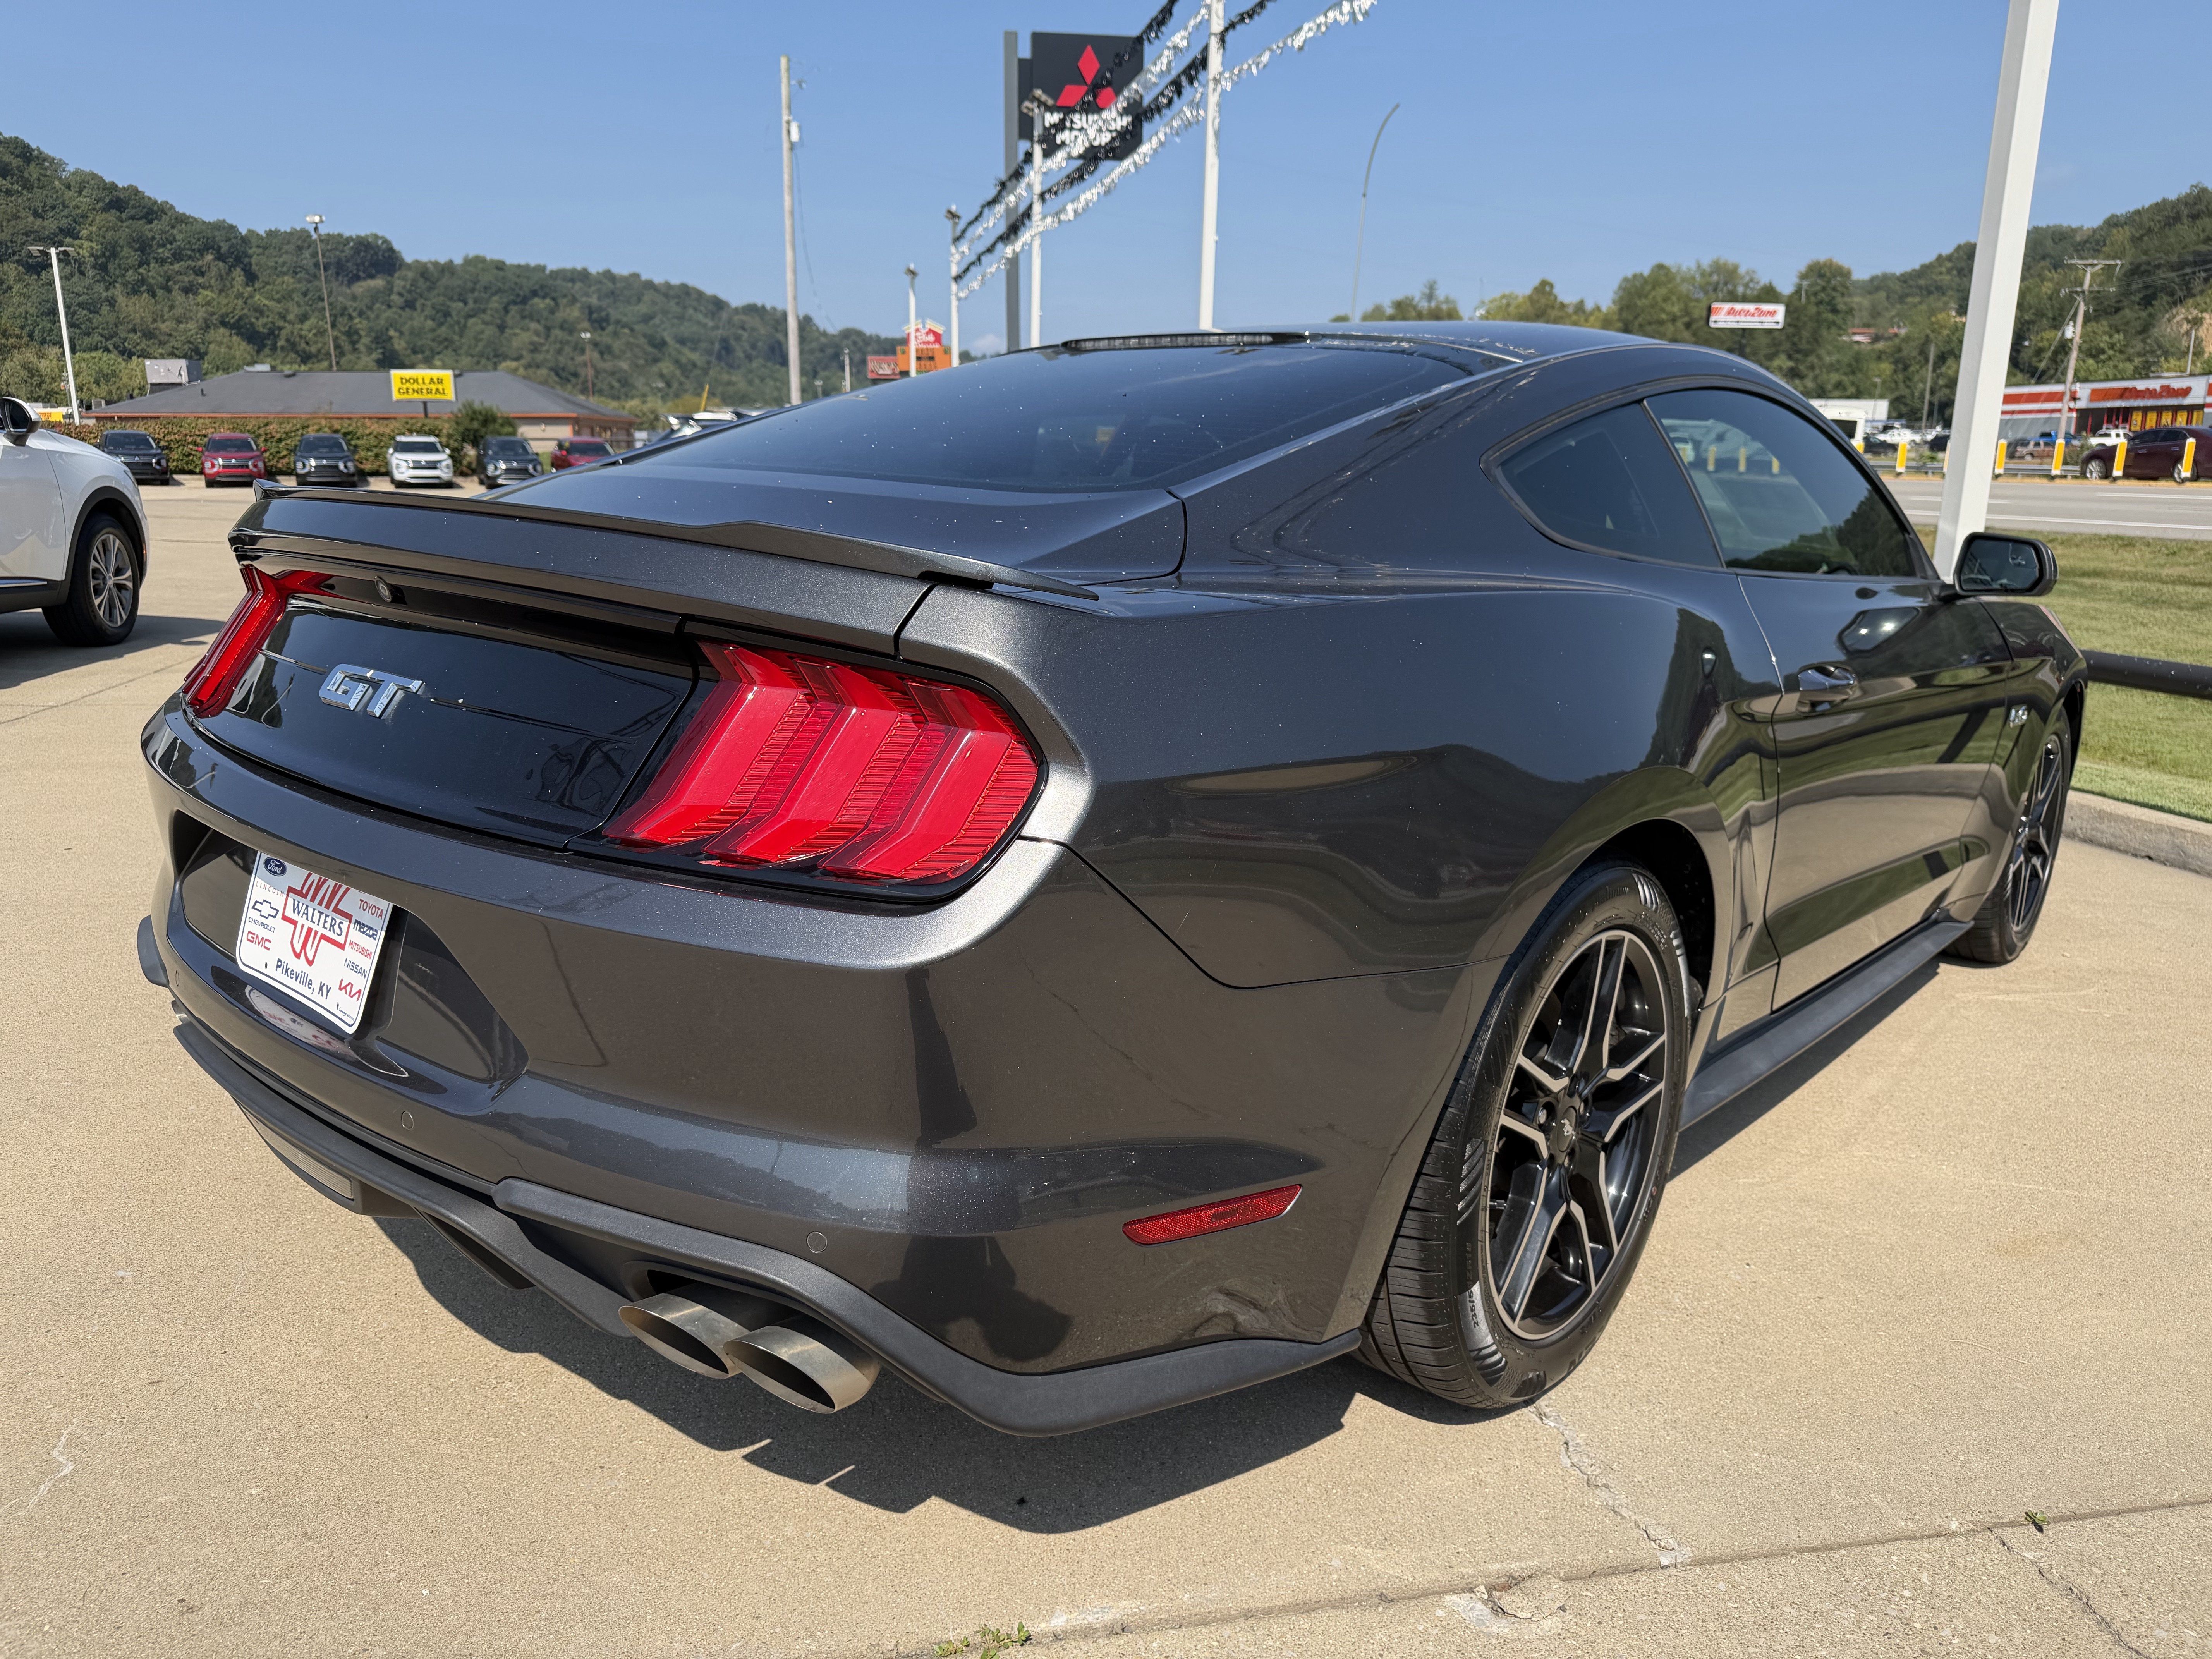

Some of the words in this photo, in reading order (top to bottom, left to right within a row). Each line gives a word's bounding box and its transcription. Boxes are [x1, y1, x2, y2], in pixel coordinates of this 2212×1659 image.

[398, 387, 446, 395] GENERAL
[400, 377, 443, 385] DOLLAR
[319, 664, 423, 717] GT
[267, 859, 283, 874] Ford
[256, 881, 285, 897] LINCOLN
[292, 898, 344, 937] WALTERS
[359, 899, 383, 920] TOYOTA
[248, 917, 276, 933] CHEVROLET
[353, 919, 378, 941] mazda
[246, 931, 272, 951] GMC
[348, 939, 373, 960] MITSUBISHI
[275, 958, 314, 994] Pikeville,
[318, 981, 332, 1000] KY
[343, 958, 368, 979] NISSAN
[338, 978, 362, 1002] KIA
